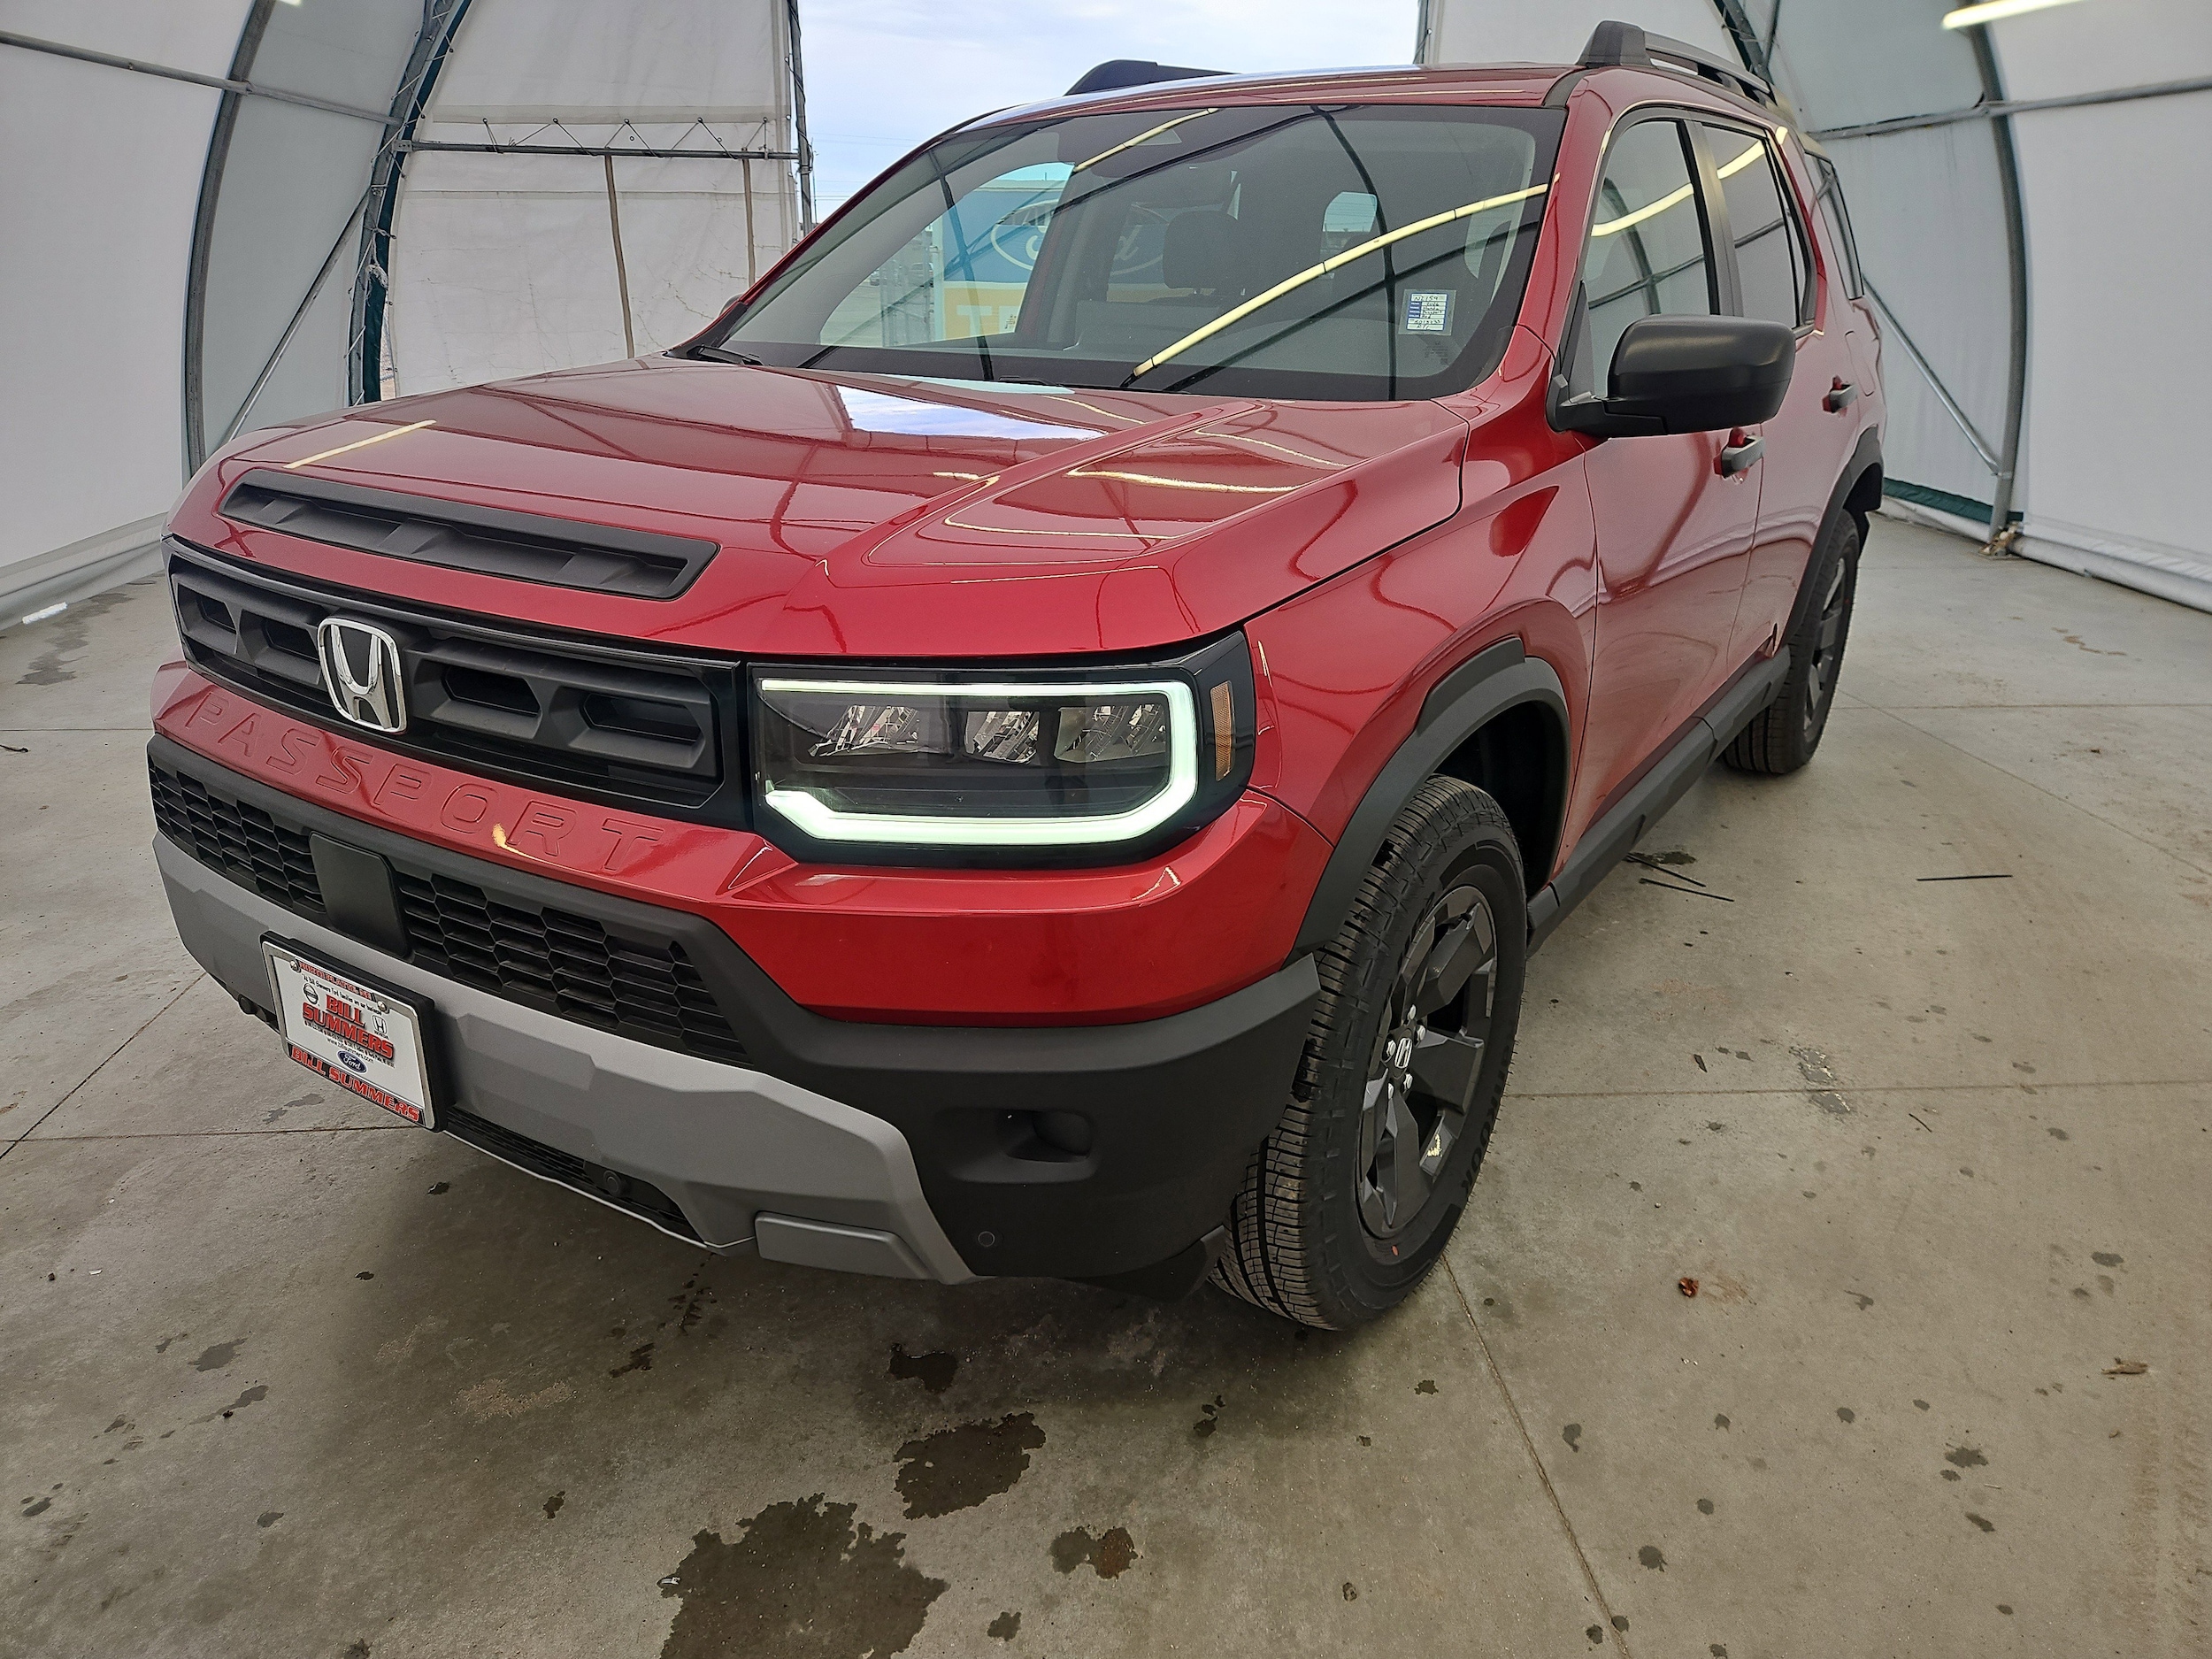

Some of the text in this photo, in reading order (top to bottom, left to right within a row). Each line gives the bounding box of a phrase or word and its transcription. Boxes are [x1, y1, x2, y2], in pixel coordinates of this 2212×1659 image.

[185, 691, 664, 872] PASSPORT
[303, 1002, 395, 1060] SUMMERS
[325, 994, 365, 1027] BILL
[291, 1046, 420, 1123] BILL SUMMERS
